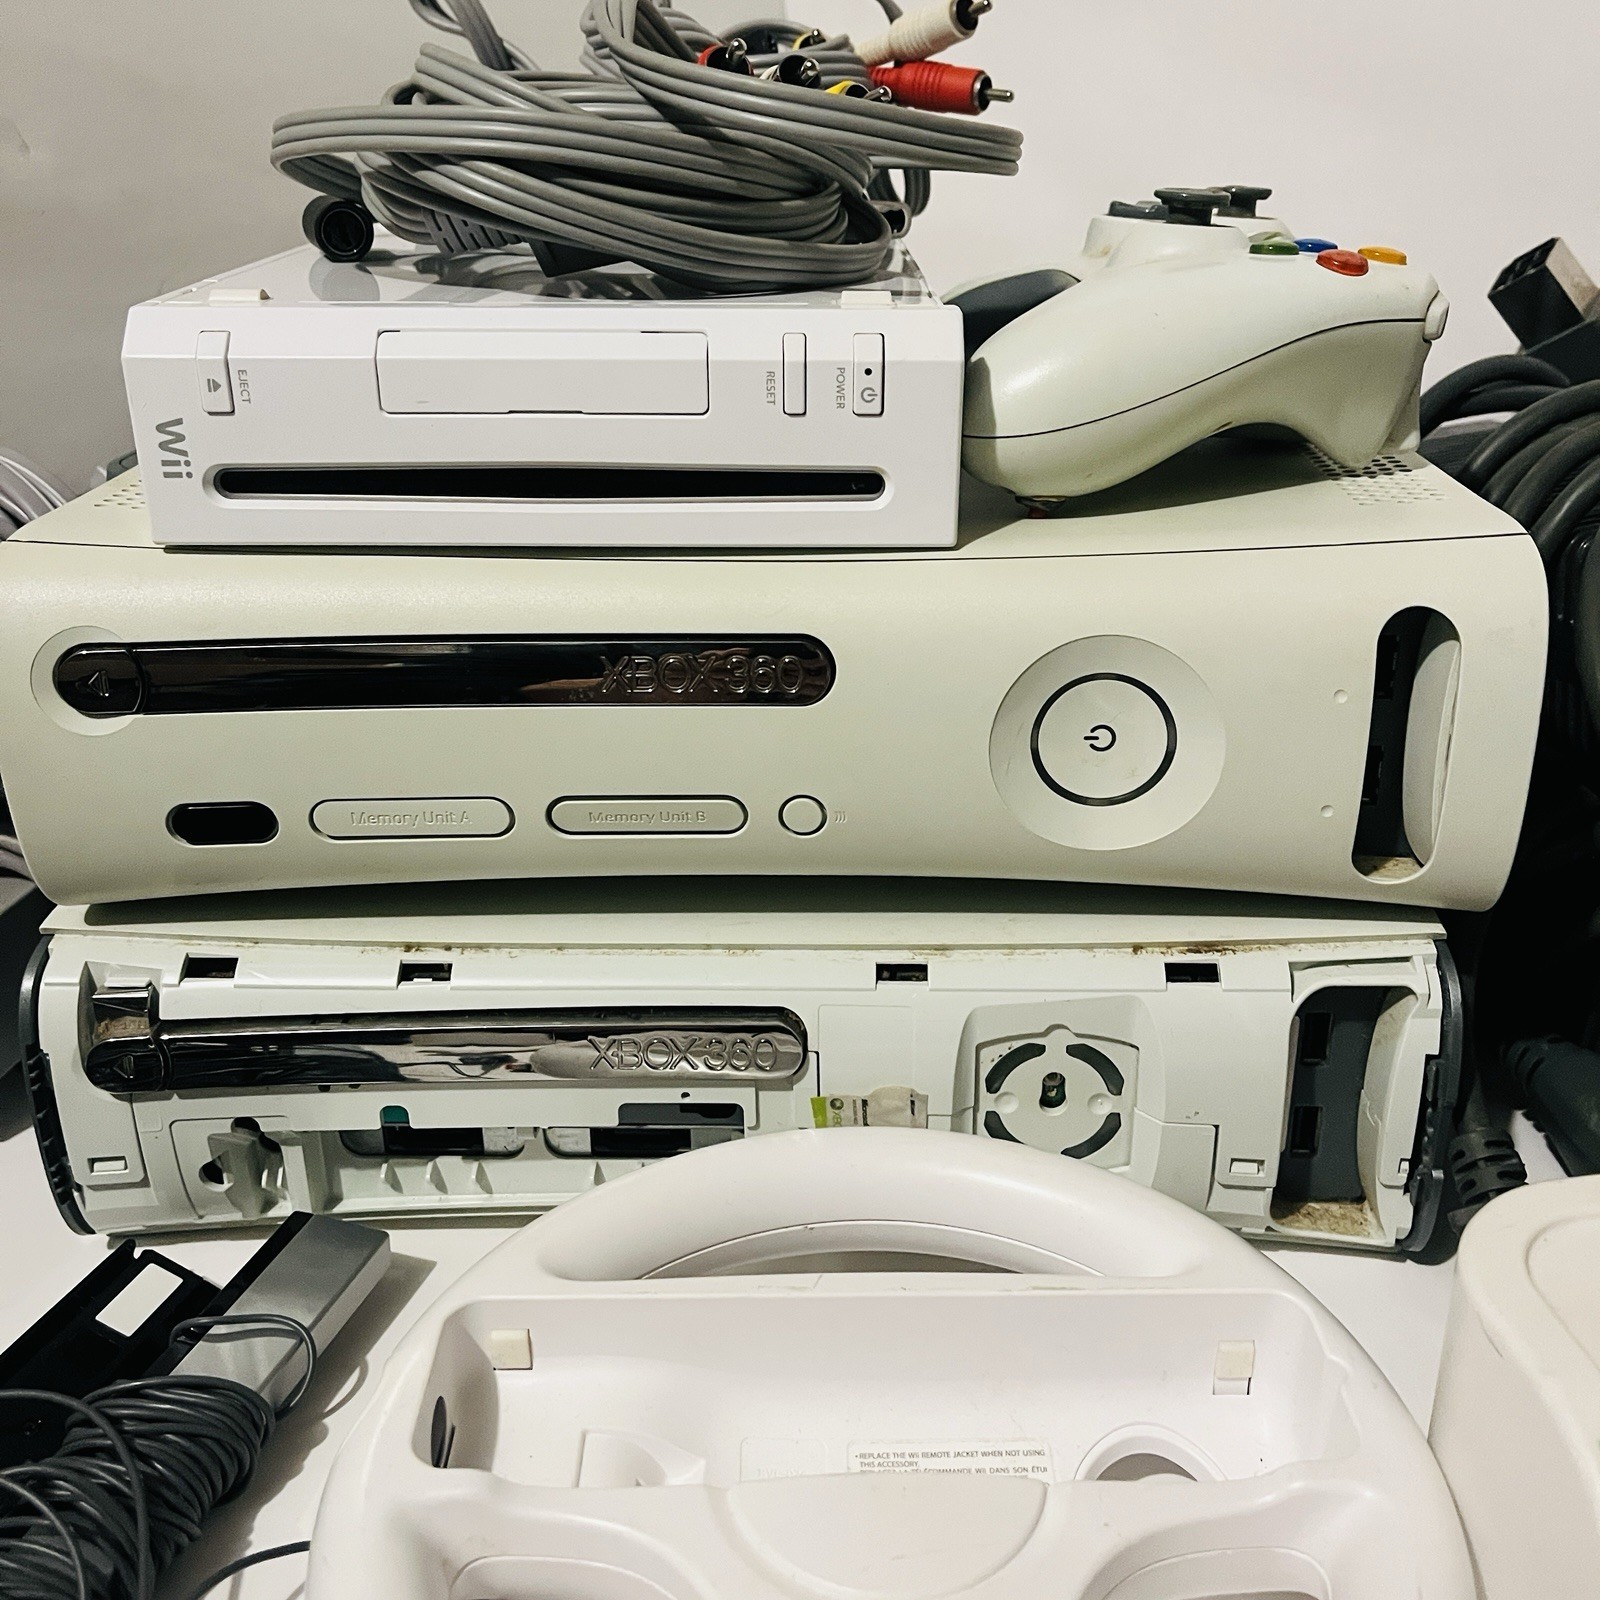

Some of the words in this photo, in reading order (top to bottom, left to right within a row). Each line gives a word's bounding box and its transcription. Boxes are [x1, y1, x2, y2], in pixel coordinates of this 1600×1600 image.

[237, 369, 251, 404] EJECT
[766, 371, 776, 405] RESET
[836, 367, 846, 409] POWER
[155, 417, 193, 478] Wii
[600, 655, 719, 694] XBOX
[725, 655, 803, 694] 360
[350, 812, 419, 828] Memory
[422, 810, 457, 825] Unit
[460, 810, 473, 825] A
[588, 811, 656, 825] Memory
[659, 811, 692, 823] Unit
[695, 810, 706, 823] B
[587, 1035, 701, 1070] XBOX
[704, 1036, 777, 1071] 360
[859, 1452, 891, 1460] REPLACE
[921, 1451, 951, 1459] REMOTE
[953, 1450, 979, 1458] JACKET
[980, 1450, 1004, 1458] WHEN
[1005, 1449, 1021, 1457] NOT
[1022, 1449, 1046, 1457] USING
[989, 1466, 1010, 1474] DANS
[1012, 1465, 1029, 1473] SON
[1031, 1464, 1048, 1473] ÉTUI
